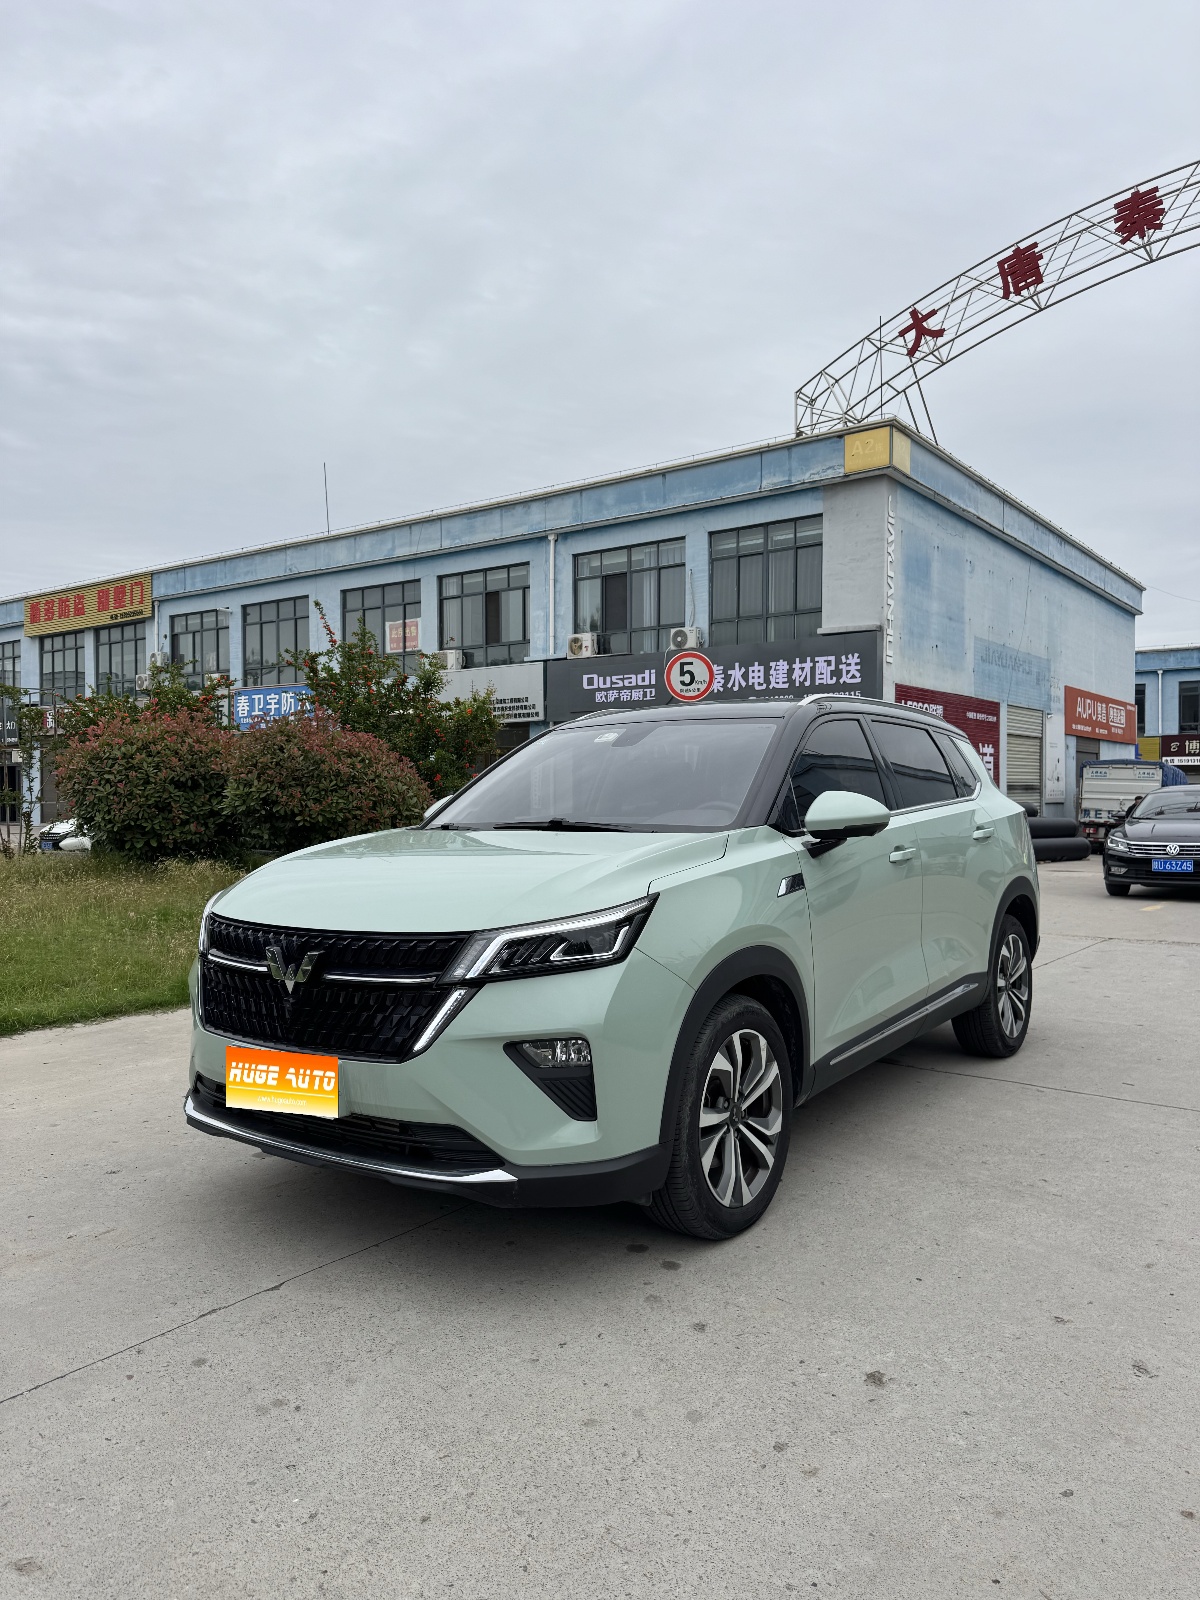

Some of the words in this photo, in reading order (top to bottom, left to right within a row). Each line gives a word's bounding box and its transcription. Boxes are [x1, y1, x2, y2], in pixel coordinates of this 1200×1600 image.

[679, 662, 695, 686] 5
[595, 688, 656, 703] 欧萨帝厨卫
